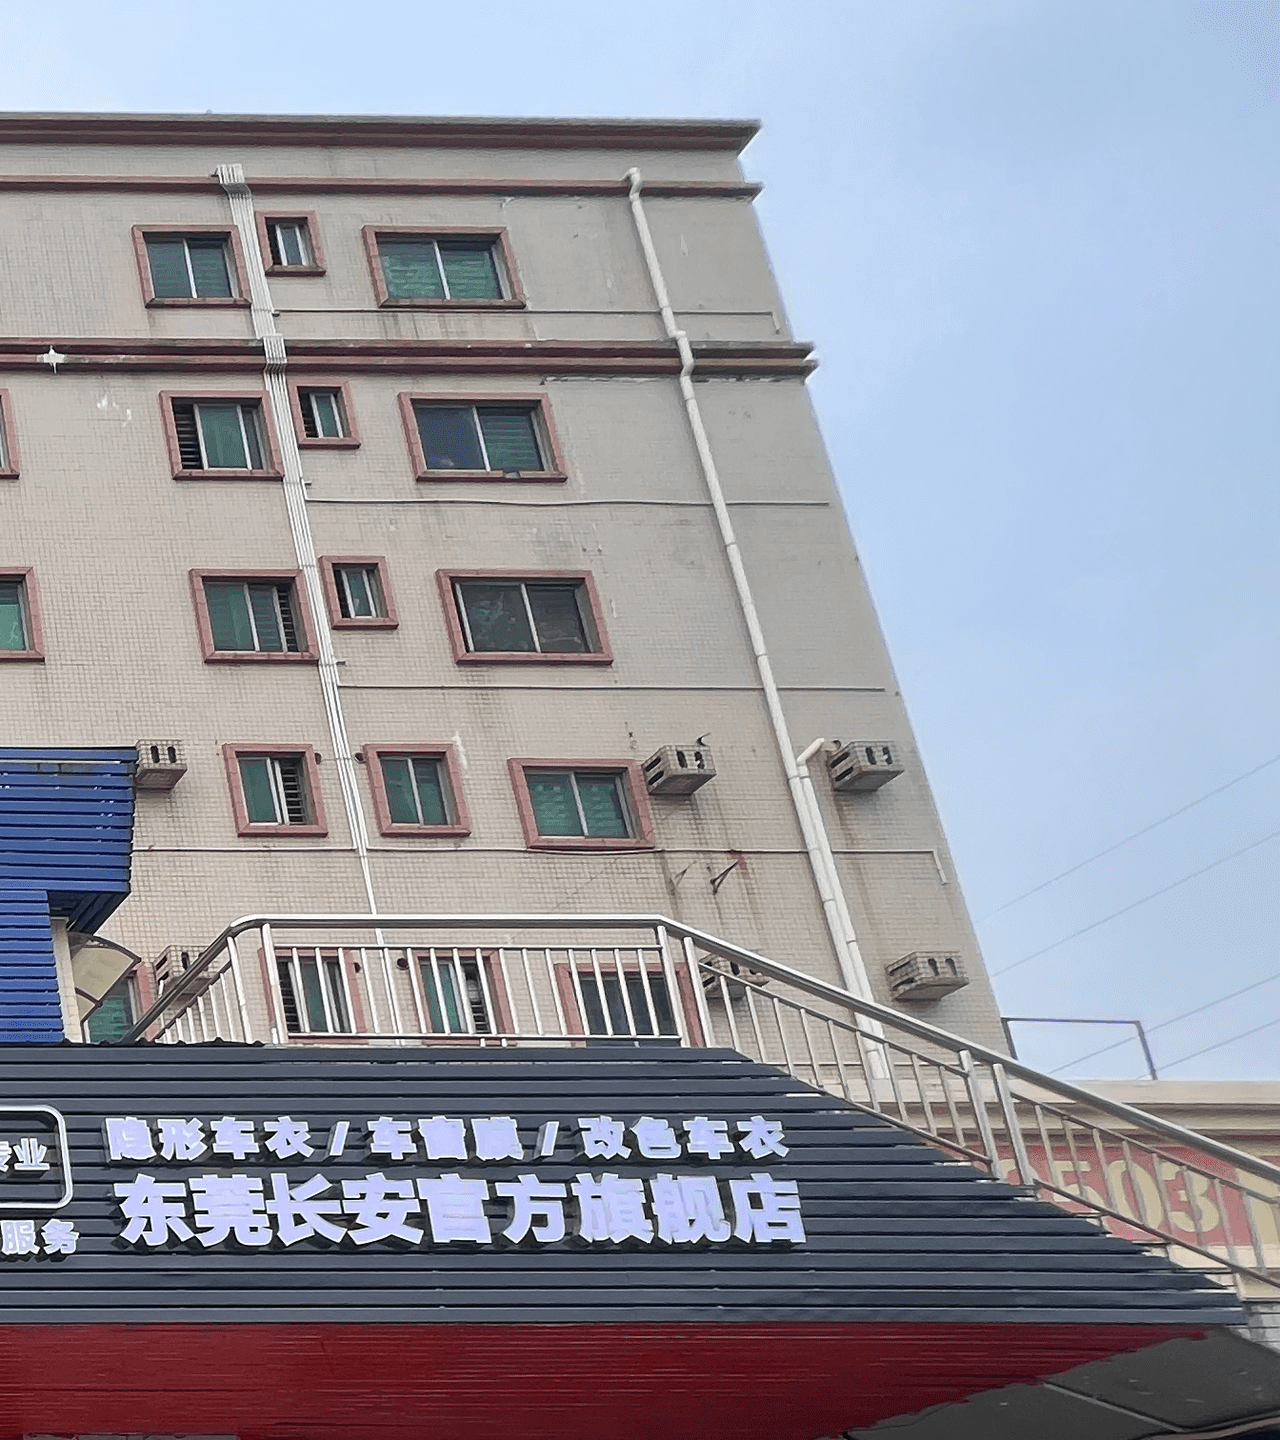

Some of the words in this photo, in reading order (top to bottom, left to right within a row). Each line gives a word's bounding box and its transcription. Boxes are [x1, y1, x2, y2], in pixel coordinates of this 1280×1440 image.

[114, 1172, 806, 1247] 东莞长安官方旗舰店
